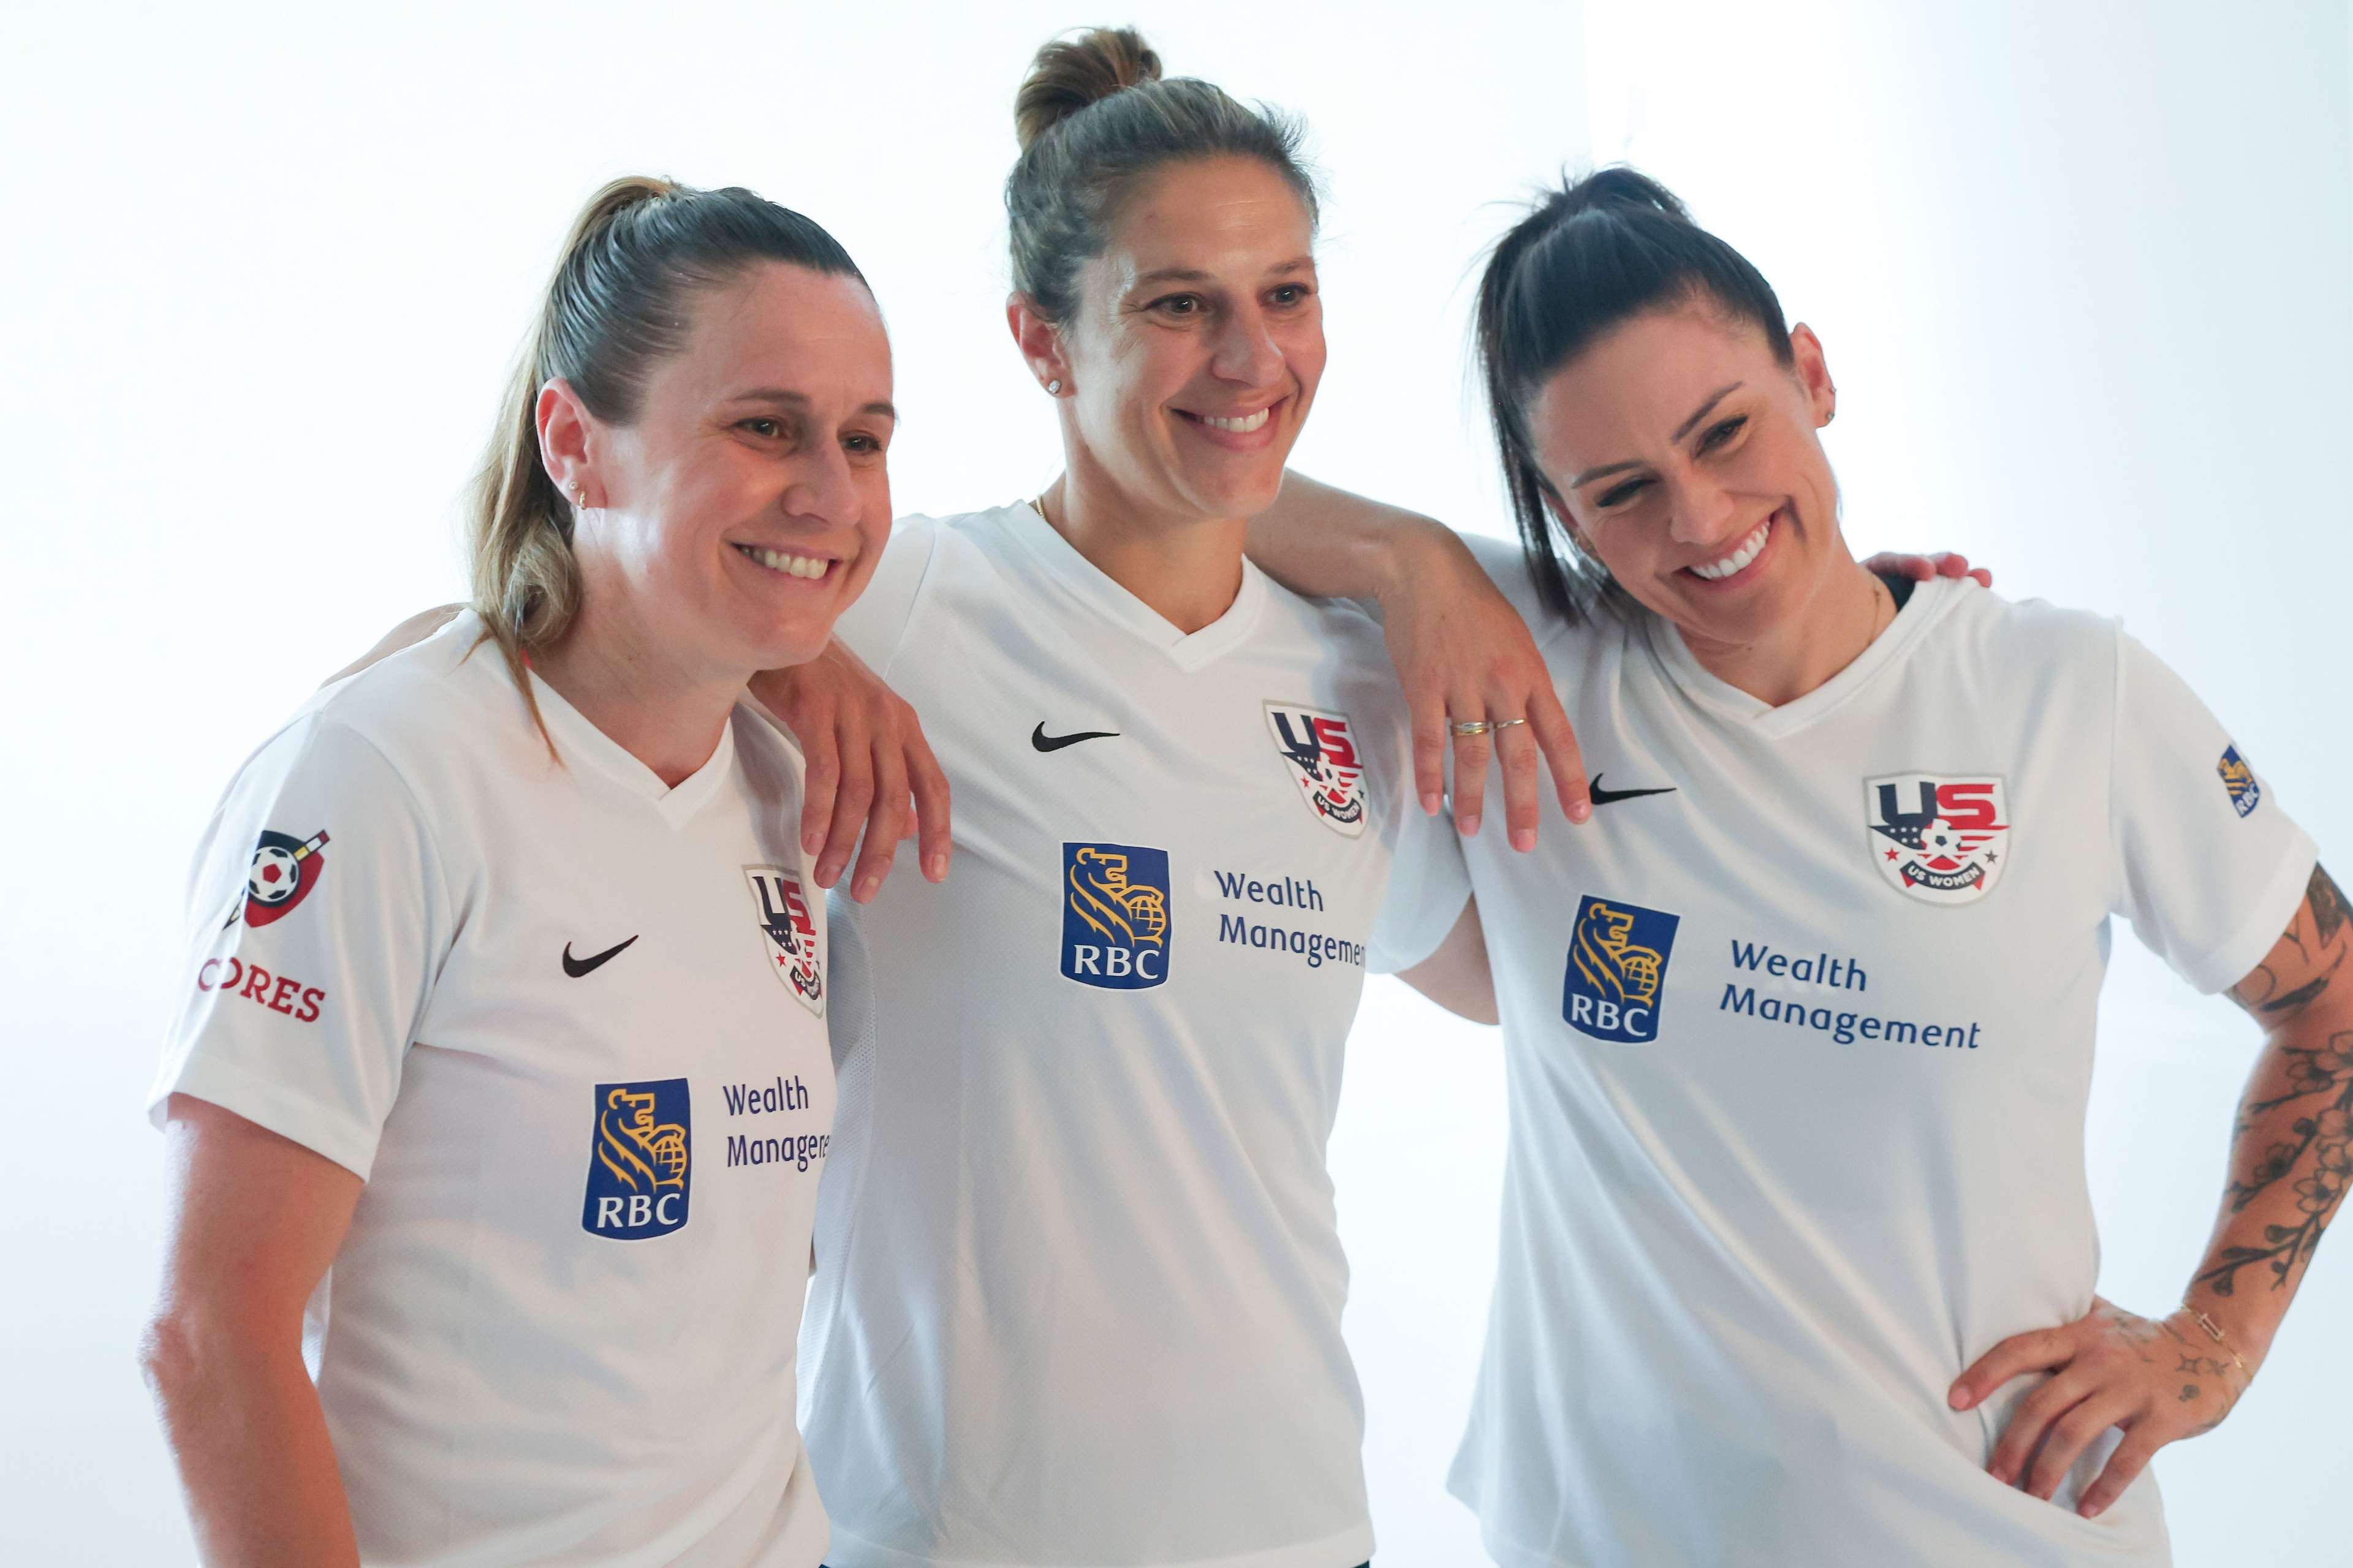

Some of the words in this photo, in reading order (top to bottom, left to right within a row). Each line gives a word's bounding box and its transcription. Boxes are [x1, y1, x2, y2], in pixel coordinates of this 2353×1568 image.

[1271, 712, 1363, 769] US
[1870, 781, 2007, 831] US
[1214, 870, 1324, 912] Wealth
[1908, 865, 1926, 881] US
[1929, 866, 1981, 887] WOMEN
[751, 876, 816, 936] US
[1074, 944, 1159, 980] RBC
[1731, 939, 1867, 991] Wealth
[1571, 993, 1650, 1037] RBC
[1719, 983, 1980, 1049] Management
[723, 1075, 809, 1116] Wealth
[597, 1193, 681, 1229] RBC
